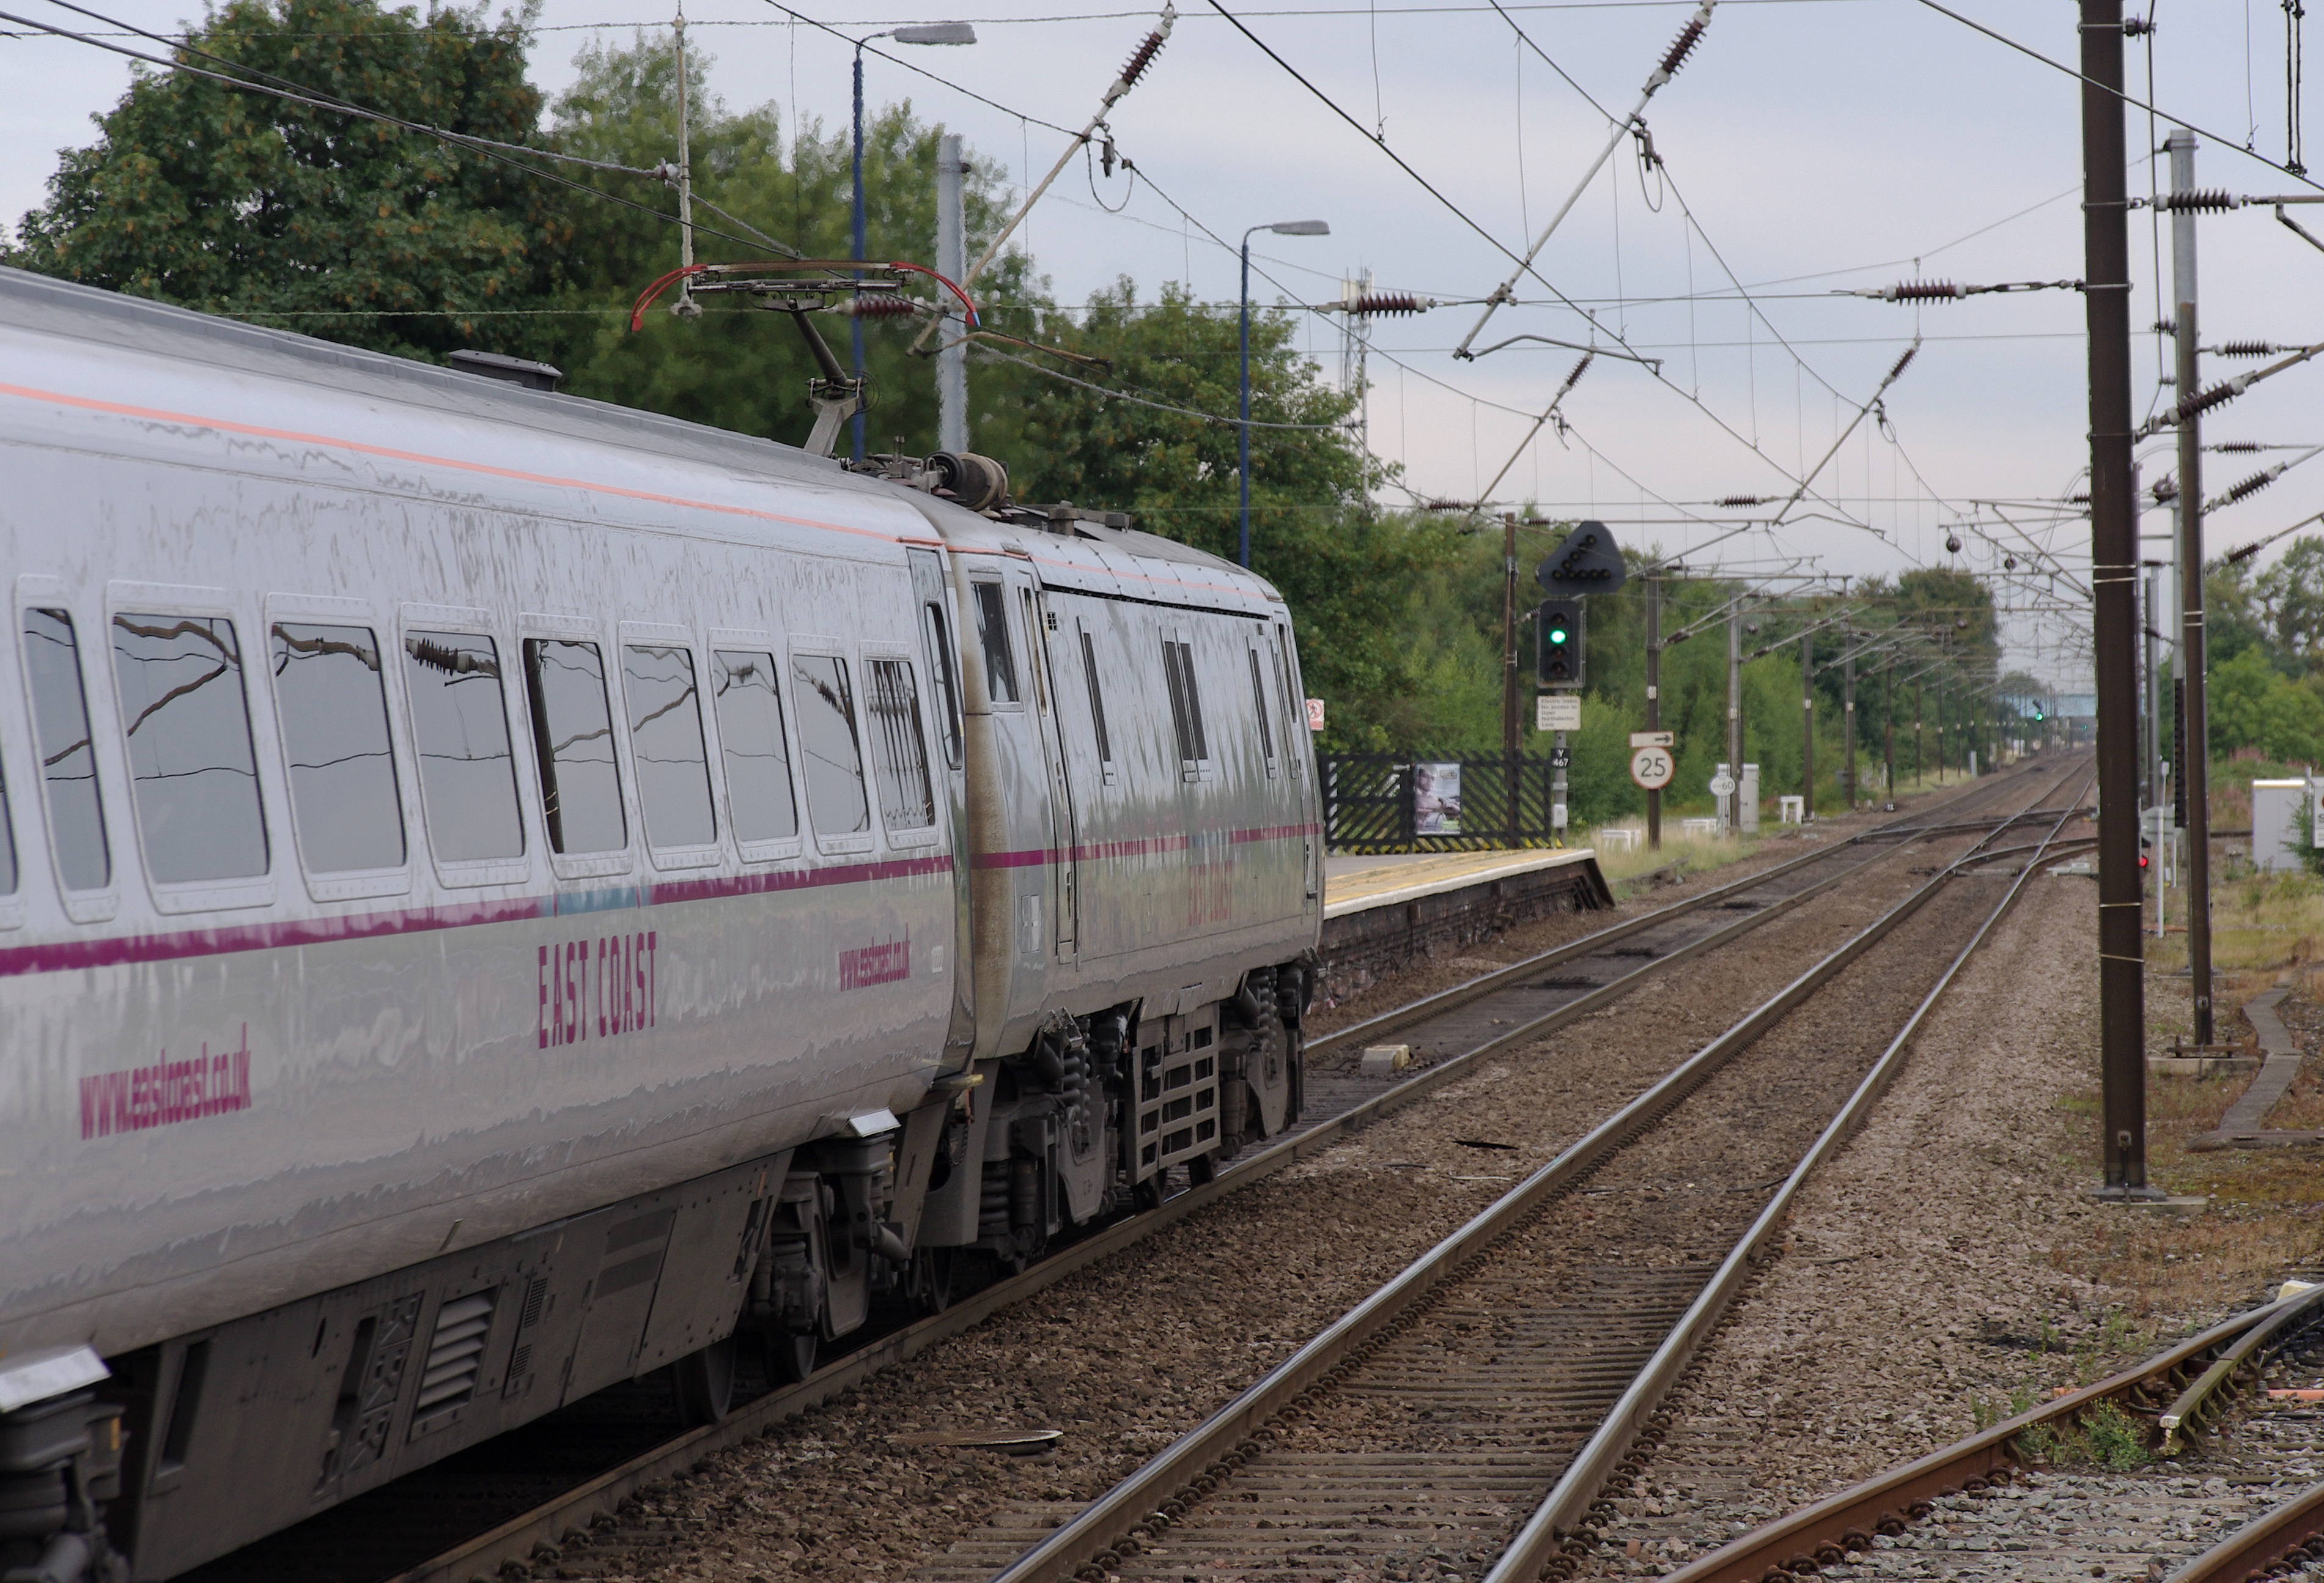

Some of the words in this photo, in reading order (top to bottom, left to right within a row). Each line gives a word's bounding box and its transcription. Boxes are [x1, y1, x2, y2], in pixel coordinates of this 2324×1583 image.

[1553, 758, 1569, 767] 467
[1558, 749, 1564, 758] Y
[1640, 758, 1666, 777] 25
[1722, 781, 1733, 791] 60
[839, 922, 911, 992] www.eastcoast.co.uk
[539, 940, 588, 1049] EAST
[599, 931, 657, 1038] COAST
[79, 1021, 252, 1141] www.eastcoast.co.uk
